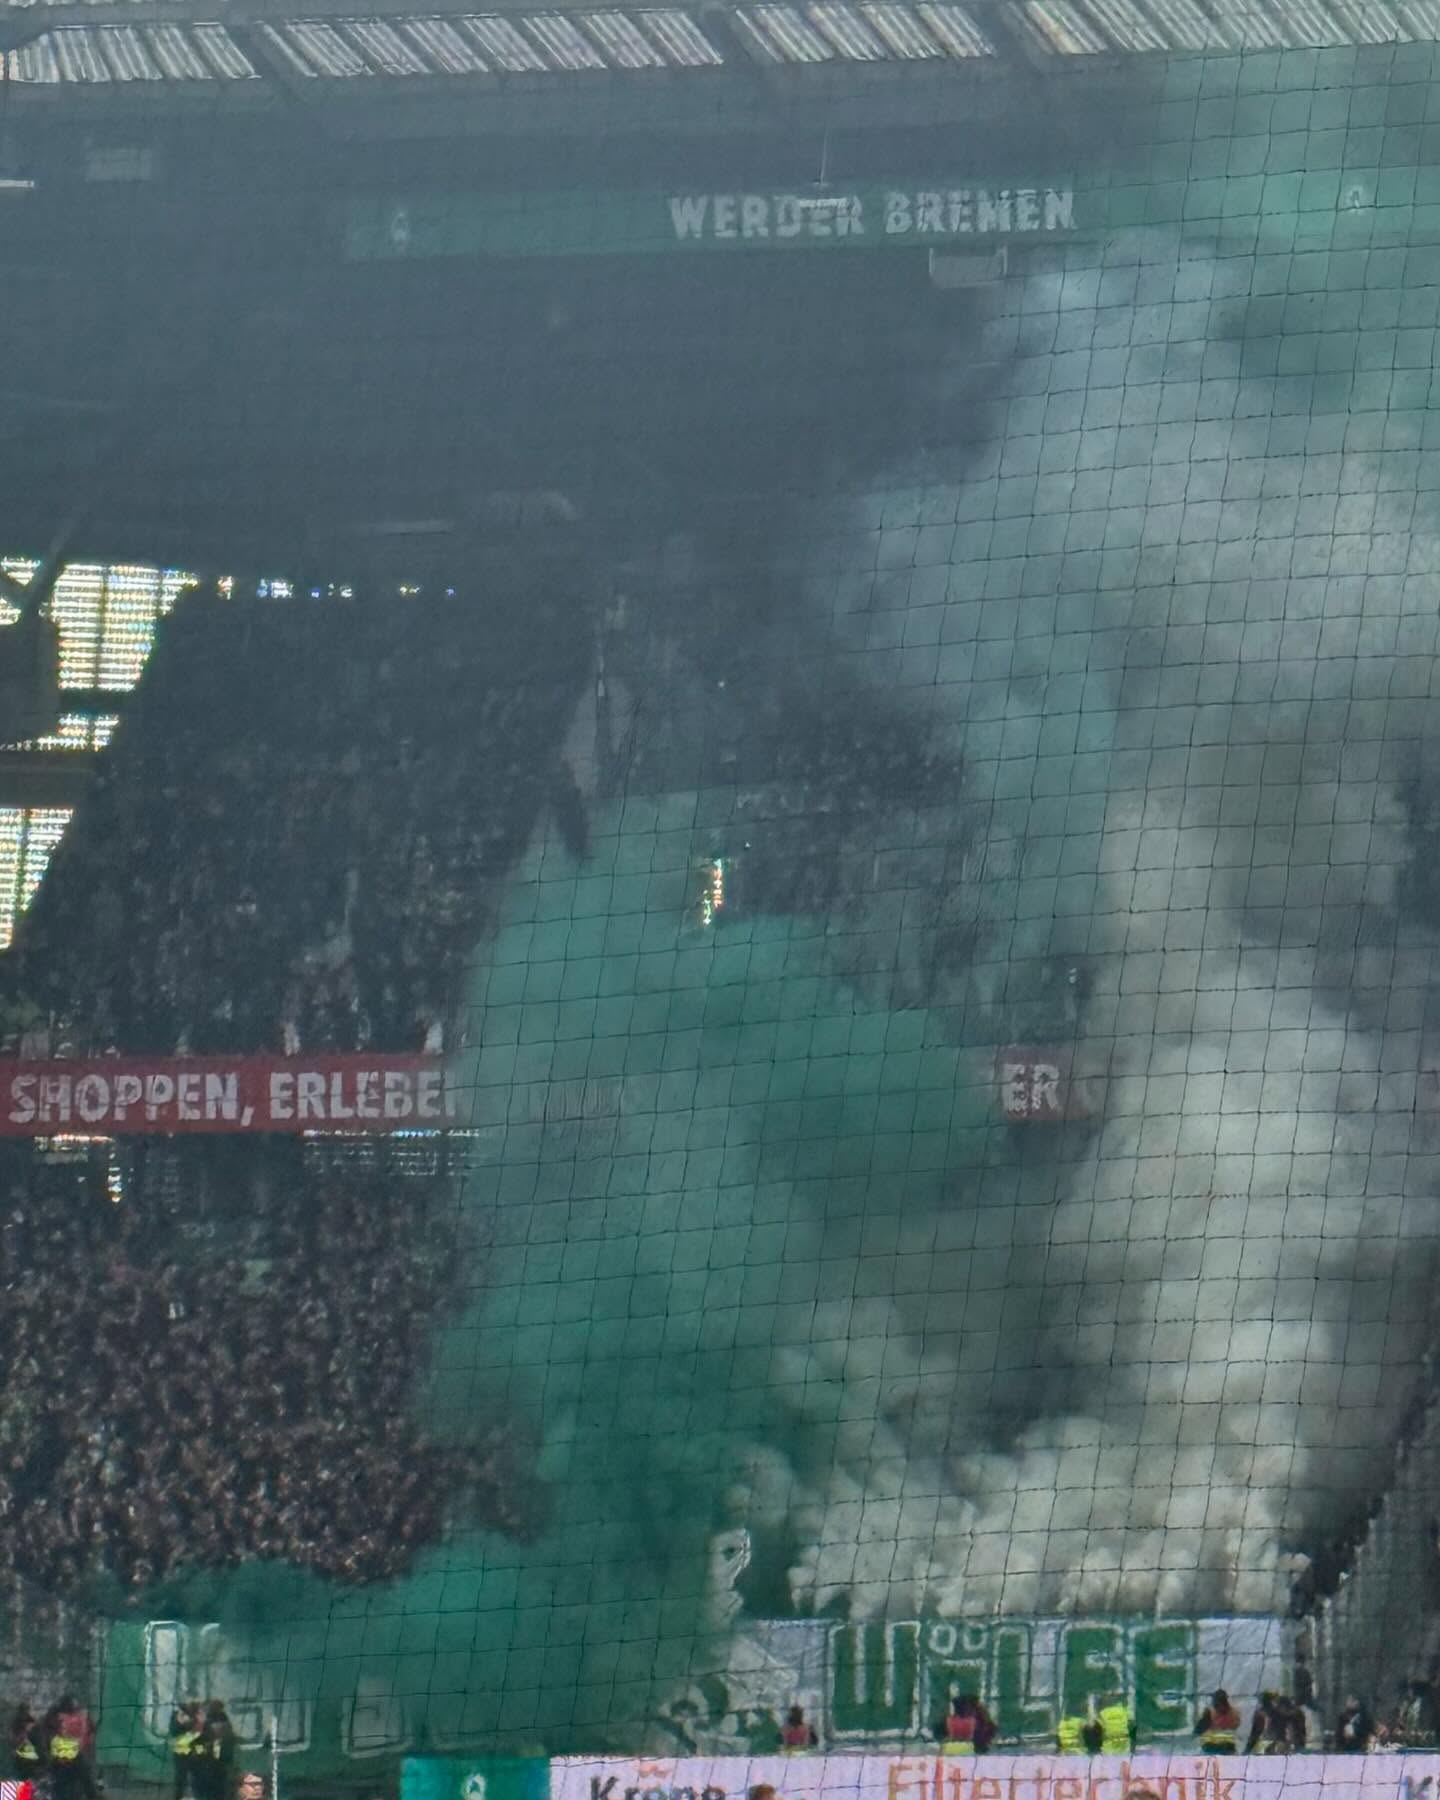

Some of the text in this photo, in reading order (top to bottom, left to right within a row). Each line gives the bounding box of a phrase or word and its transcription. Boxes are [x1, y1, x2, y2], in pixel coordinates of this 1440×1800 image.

[670, 188, 1075, 240] WERDER BREMEN
[7, 1071, 256, 1127] SHOPPEN,
